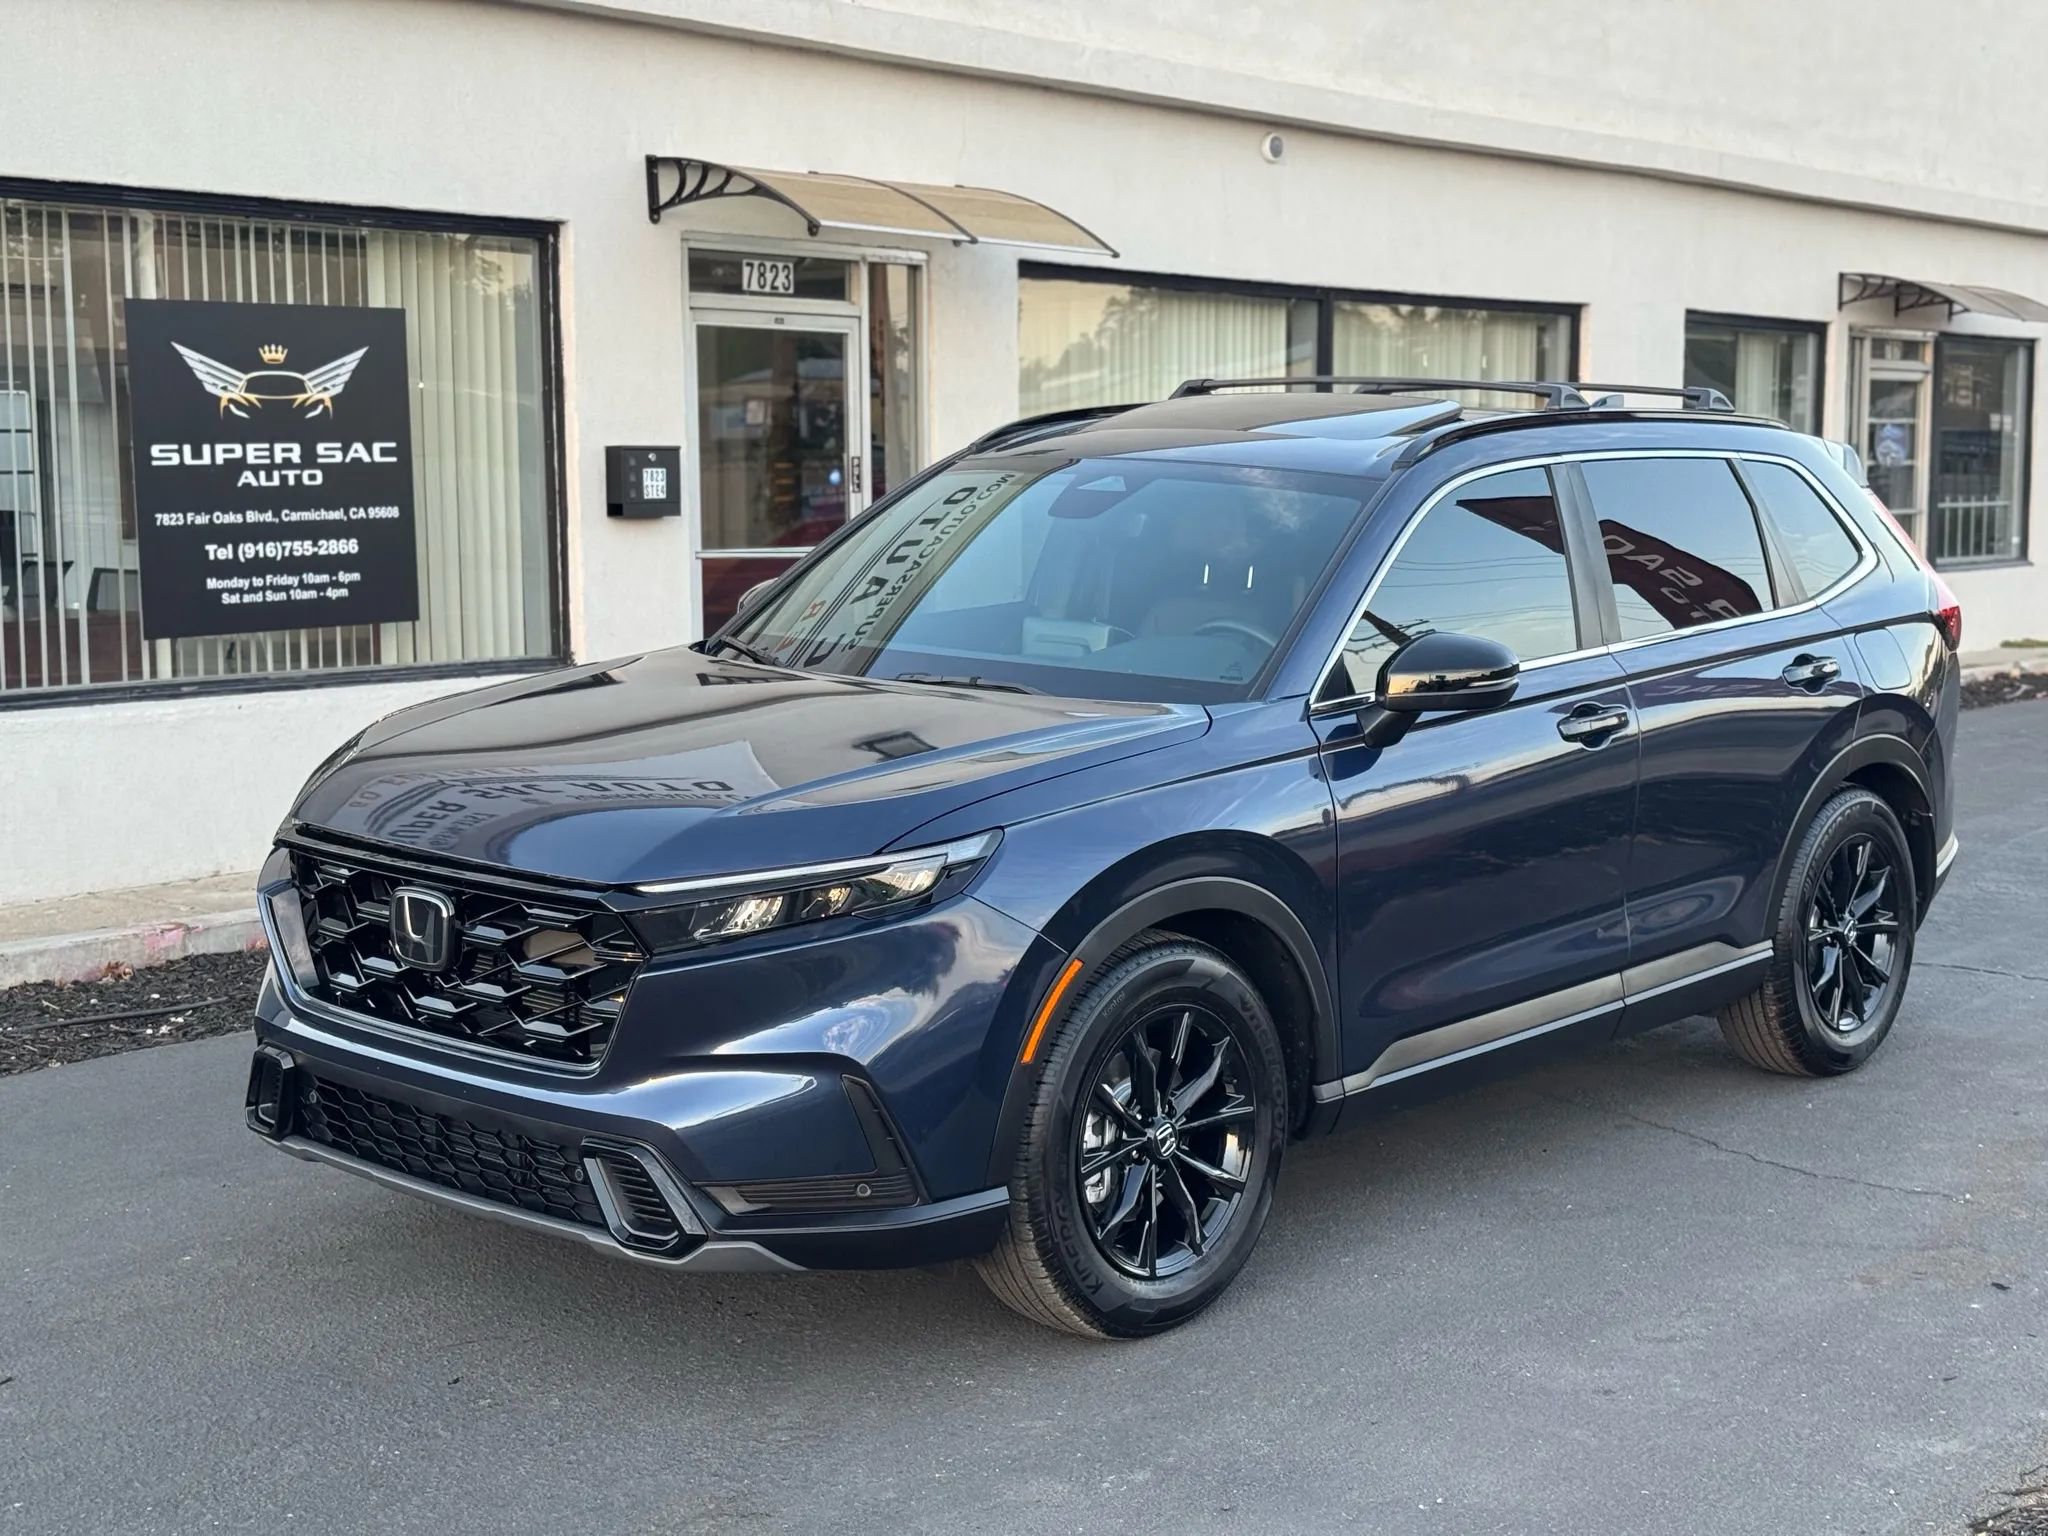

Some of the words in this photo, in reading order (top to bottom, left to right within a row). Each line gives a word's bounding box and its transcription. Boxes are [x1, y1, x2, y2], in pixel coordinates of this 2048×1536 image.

[745, 261, 791, 292] 7823
[151, 442, 302, 466] SUPER
[316, 442, 398, 463] SAC
[237, 469, 323, 487] AUTO
[644, 470, 665, 482] 7823
[155, 513, 184, 526] 7823
[187, 512, 211, 525] Fair
[212, 511, 243, 524] Oaks
[246, 509, 279, 524] Blvd.,
[281, 507, 347, 522] Carmichael,
[349, 507, 366, 519] CA
[367, 506, 399, 519] 95608
[205, 543, 233, 560] Tel
[238, 538, 359, 562] (916)755-2866
[206, 576, 250, 591] Monday
[252, 576, 264, 587] to
[265, 574, 300, 588] Friday
[302, 573, 330, 584] 10am
[338, 571, 361, 584] 6pm
[221, 592, 240, 605] Sat
[242, 591, 263, 603] and
[265, 590, 287, 602] Sun
[289, 588, 317, 600] 10am
[326, 587, 349, 599] 4pm
